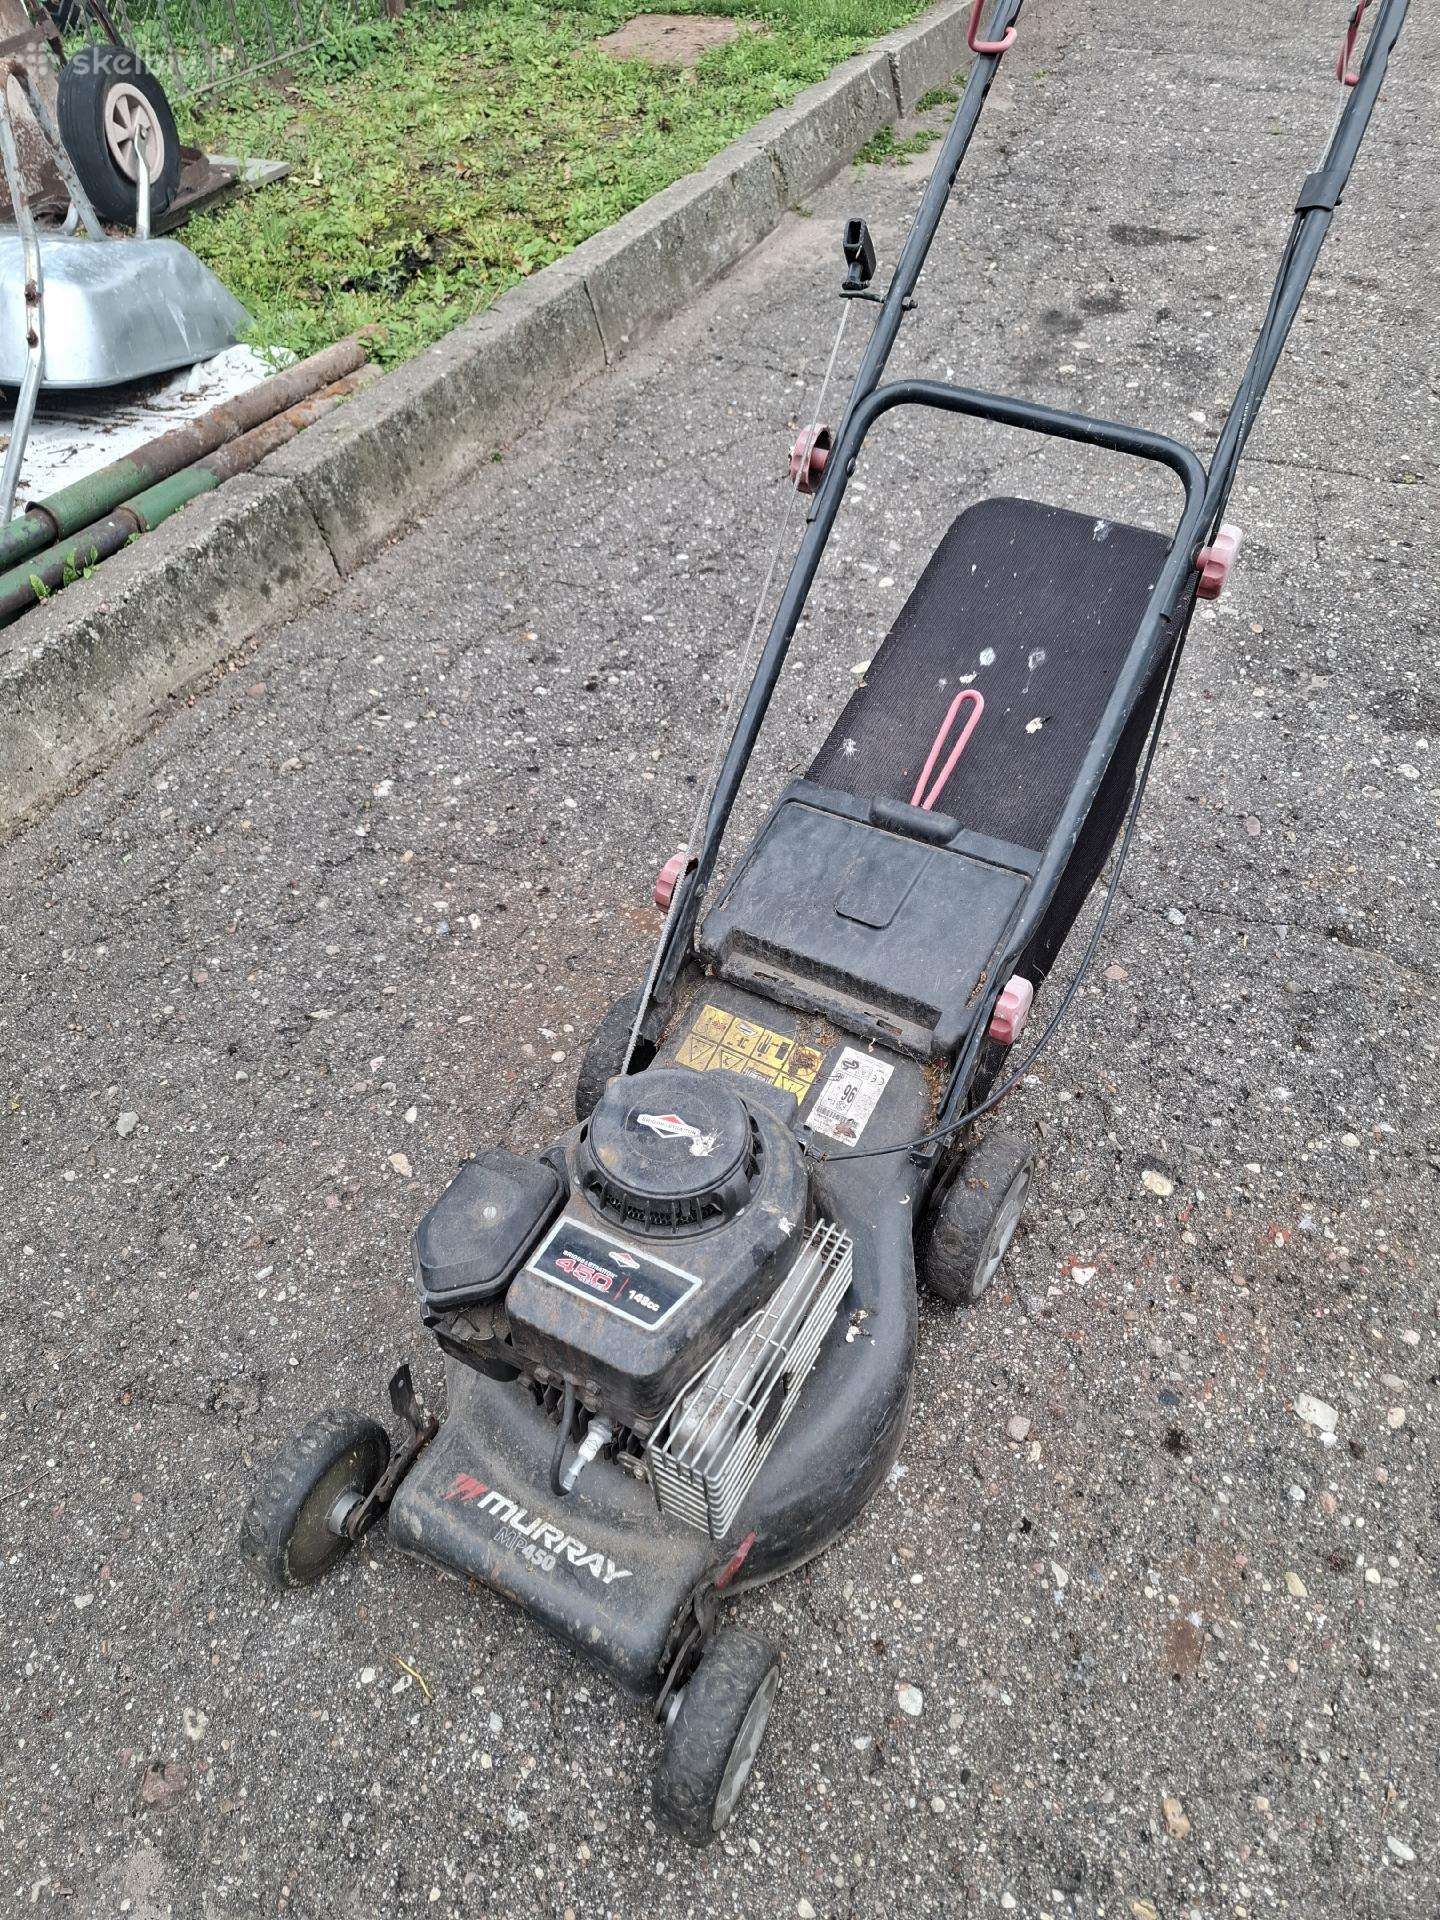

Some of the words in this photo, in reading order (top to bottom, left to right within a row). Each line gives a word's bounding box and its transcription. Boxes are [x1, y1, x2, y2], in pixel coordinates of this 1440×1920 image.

[841, 1084, 858, 1103] 96
[555, 1257, 613, 1292] 450
[628, 1289, 661, 1312] 148cc
[476, 1490, 634, 1585] MURRAY
